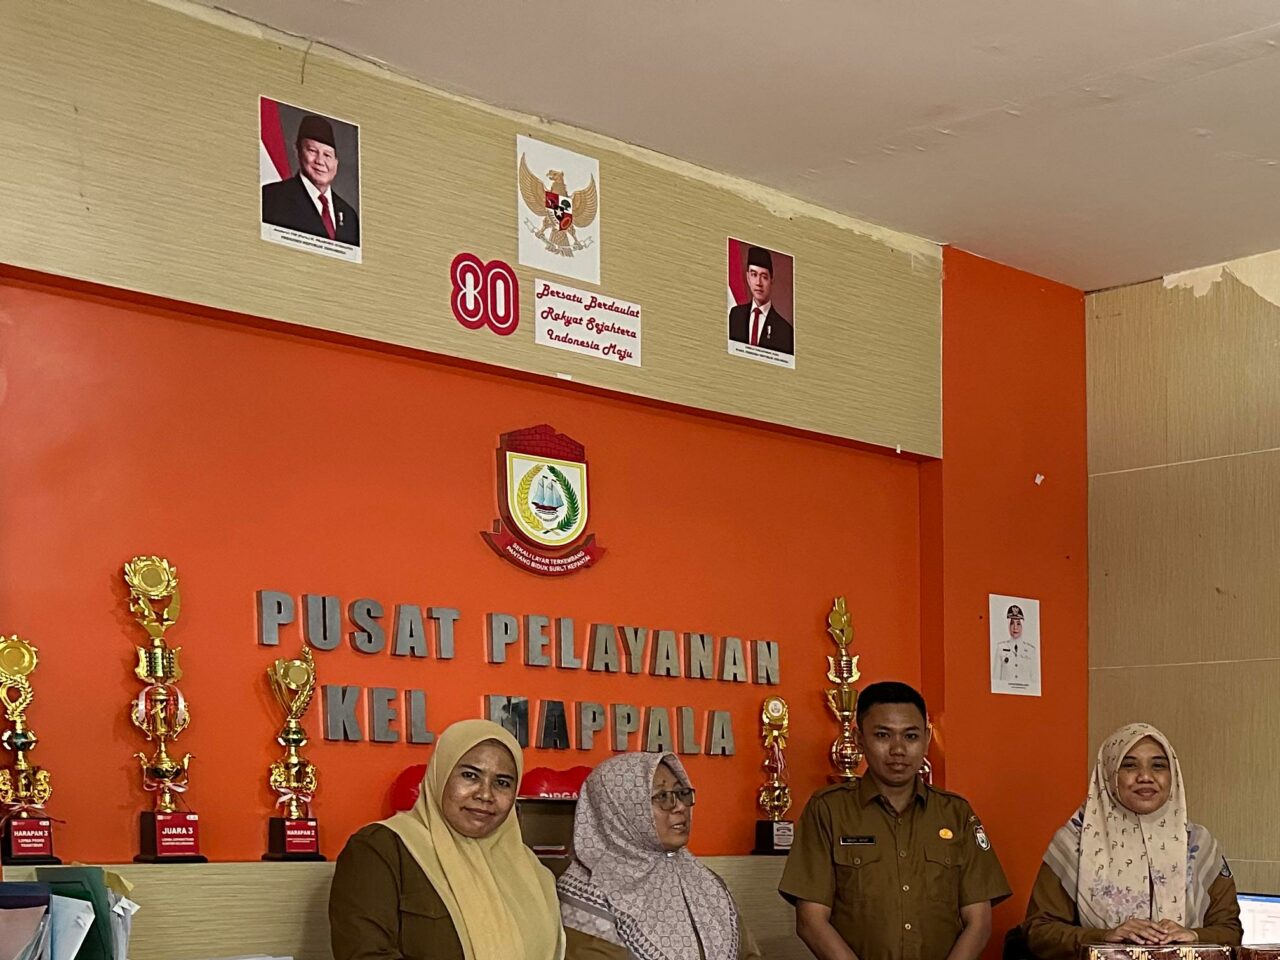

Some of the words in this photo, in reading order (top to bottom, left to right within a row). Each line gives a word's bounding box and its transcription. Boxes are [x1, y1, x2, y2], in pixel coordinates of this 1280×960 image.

[450, 252, 520, 336] 80
[536, 283, 583, 304] Bersatu
[584, 295, 640, 318] Berdaulat
[540, 306, 584, 327] Rakyat
[585, 317, 637, 339] Sejahtera
[546, 328, 600, 351] Indonesia
[602, 344, 633, 361] Maju
[256, 589, 460, 659] PUSAT
[485, 612, 782, 685] PELAYANAN
[320, 684, 435, 745] KEL
[485, 694, 736, 757] MAPPALA
[161, 826, 187, 835] JUARA
[188, 826, 194, 835] 3
